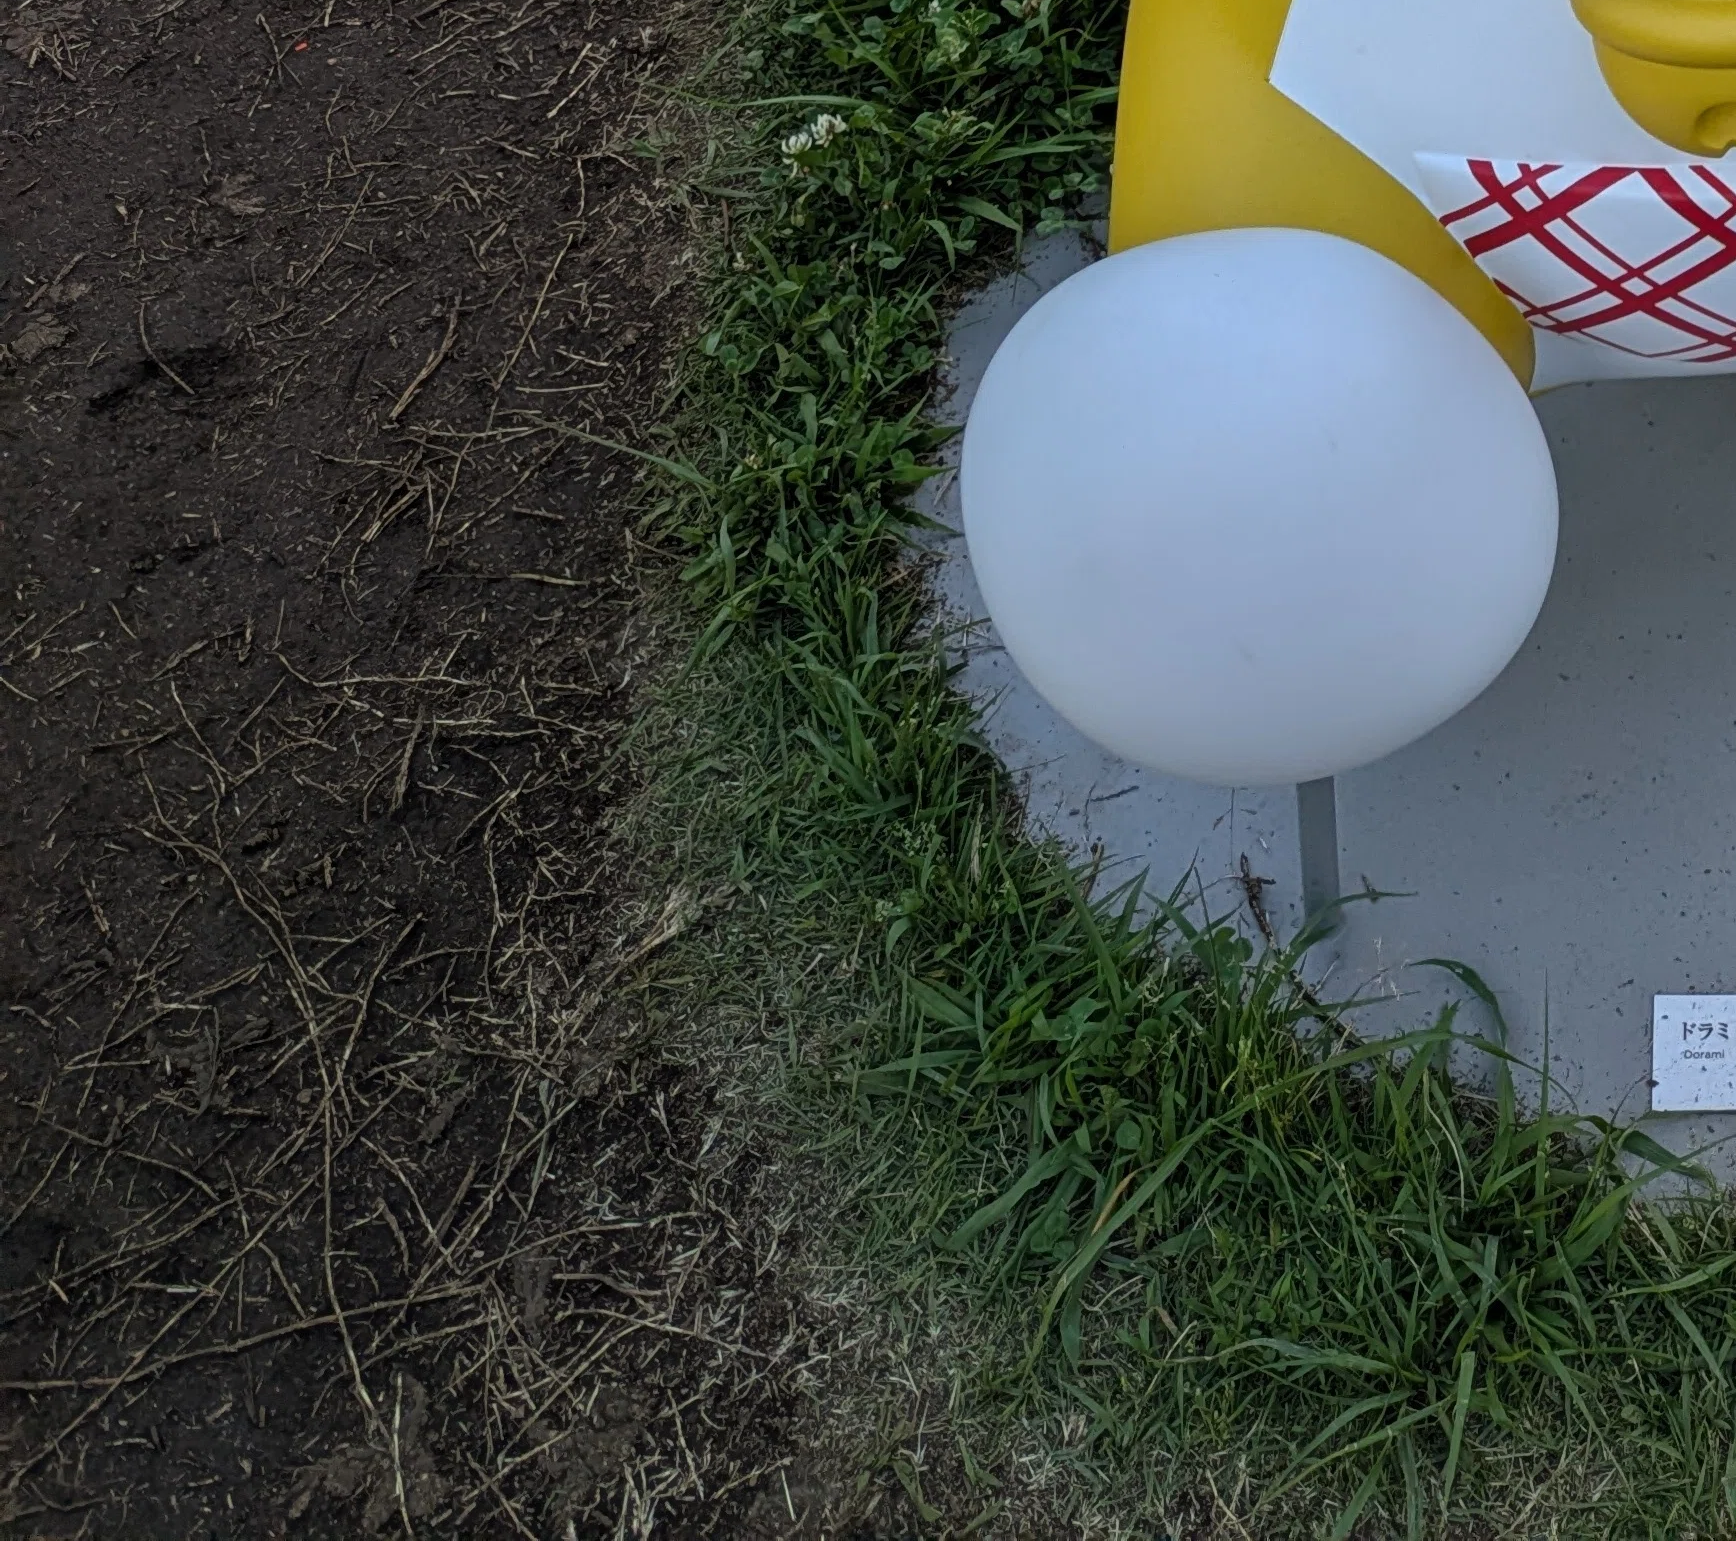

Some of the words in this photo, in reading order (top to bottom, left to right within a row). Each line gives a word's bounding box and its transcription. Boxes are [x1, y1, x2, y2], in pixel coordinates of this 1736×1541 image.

[1682, 1021, 1729, 1041] ドラミ
[1684, 1049, 1725, 1059] Dorami
